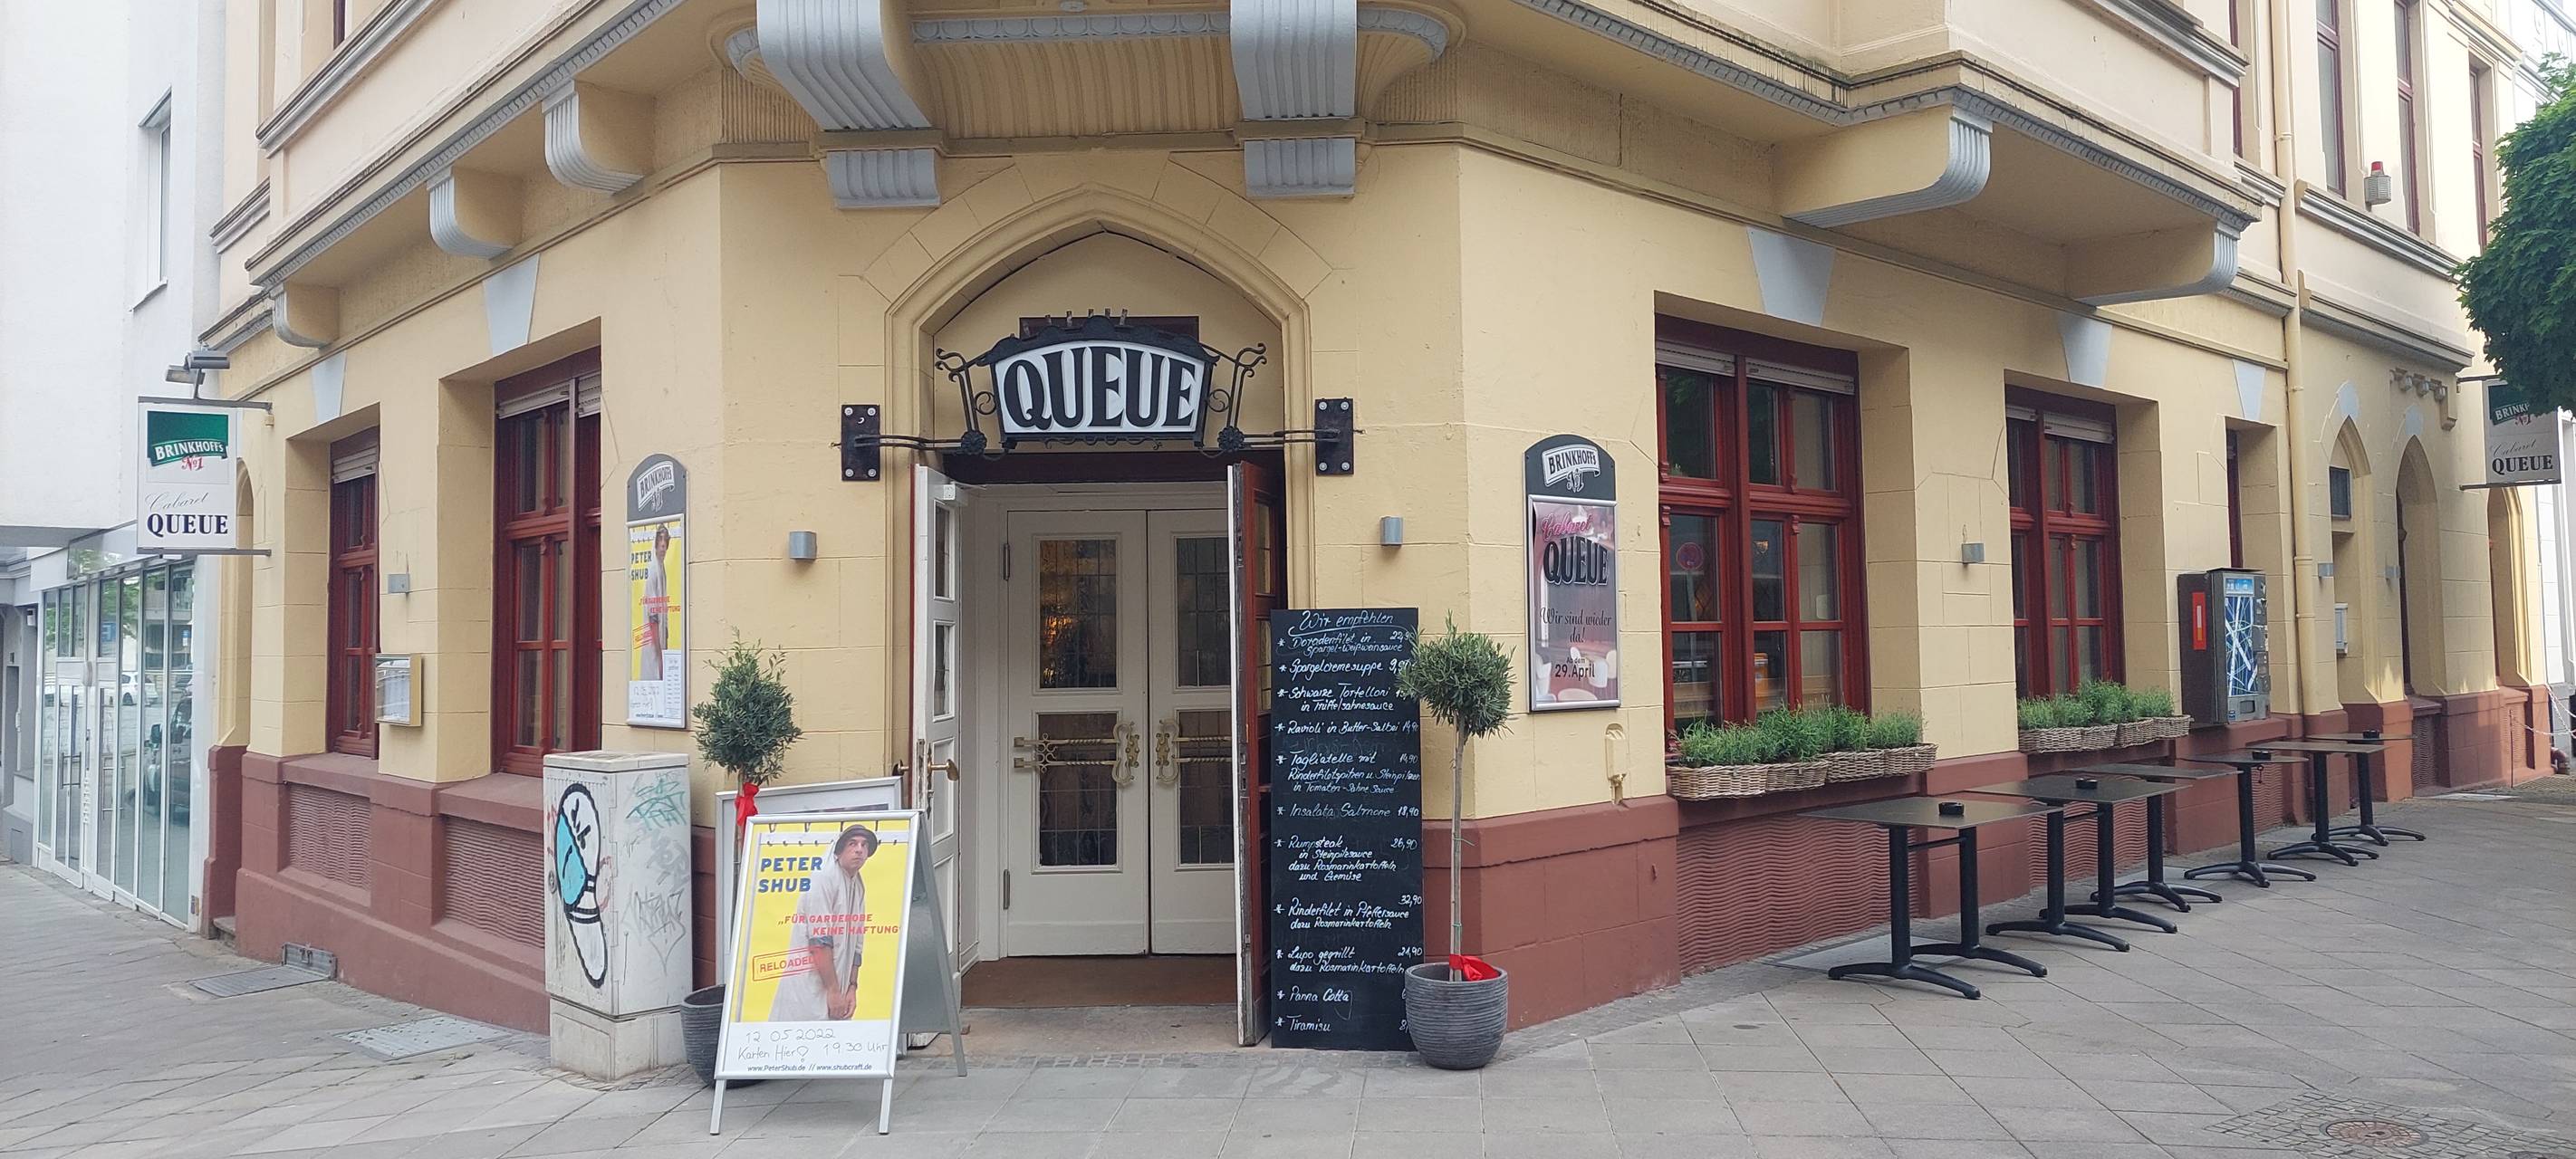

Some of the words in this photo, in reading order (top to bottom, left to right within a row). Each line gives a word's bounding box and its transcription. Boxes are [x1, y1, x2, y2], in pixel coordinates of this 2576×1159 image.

[1004, 346, 1197, 430] QUEUE
[2494, 438, 2536, 456] Cabaret
[2492, 455, 2552, 475] QUEUE
[145, 493, 208, 511] Cabaret
[147, 513, 228, 537] QUEUE
[1542, 512, 1594, 542] Cabaret
[630, 551, 652, 564] PETER
[1543, 536, 1609, 585] QUEUE
[630, 568, 649, 580] SHUB
[1300, 610, 1331, 630] Wir
[1336, 610, 1395, 631] empfehlen
[1540, 607, 1562, 624] Wir
[1564, 609, 1583, 625] sind
[1586, 610, 1611, 626] wieder
[1570, 627, 1585, 643] da!
[1289, 686, 1333, 699] Schwarze
[1301, 701, 1310, 712] in
[1287, 721, 1323, 734] Ravioli
[1327, 722, 1337, 733] in
[1290, 750, 1353, 771] Tagliatelle
[1358, 751, 1377, 764] mit
[1293, 781, 1302, 791] in
[1341, 803, 1390, 817] Salmone
[1289, 835, 1343, 850] Rumpsteak
[1299, 849, 1308, 858] in
[760, 857, 823, 872] PETER
[1289, 860, 1310, 871] dazu
[1313, 860, 1397, 871] Rosmarinkartoffeln
[1299, 871, 1318, 881] und
[1324, 870, 1362, 882] Gemüse
[758, 877, 812, 893] SHUB
[1288, 897, 1341, 916] Rinderfilet
[1343, 905, 1353, 916] in
[1355, 901, 1409, 918] Pfeffersauce
[810, 914, 872, 924] GARDEROBE
[1291, 917, 1311, 929] dazu
[1314, 916, 1392, 929] Rosmarinkartoffeln
[812, 926, 844, 935] KEINE
[1288, 951, 1314, 961] Lupo
[1313, 951, 1355, 966] gegrillt
[1290, 963, 1312, 972] dazu
[1289, 986, 1319, 1001] Panna
[1322, 989, 1350, 1001] Cotta
[1286, 1015, 1331, 1031] Tiramisu
[796, 1029, 836, 1039] 2022
[738, 1046, 770, 1060] Karten
[868, 1042, 888, 1051] Uhr
